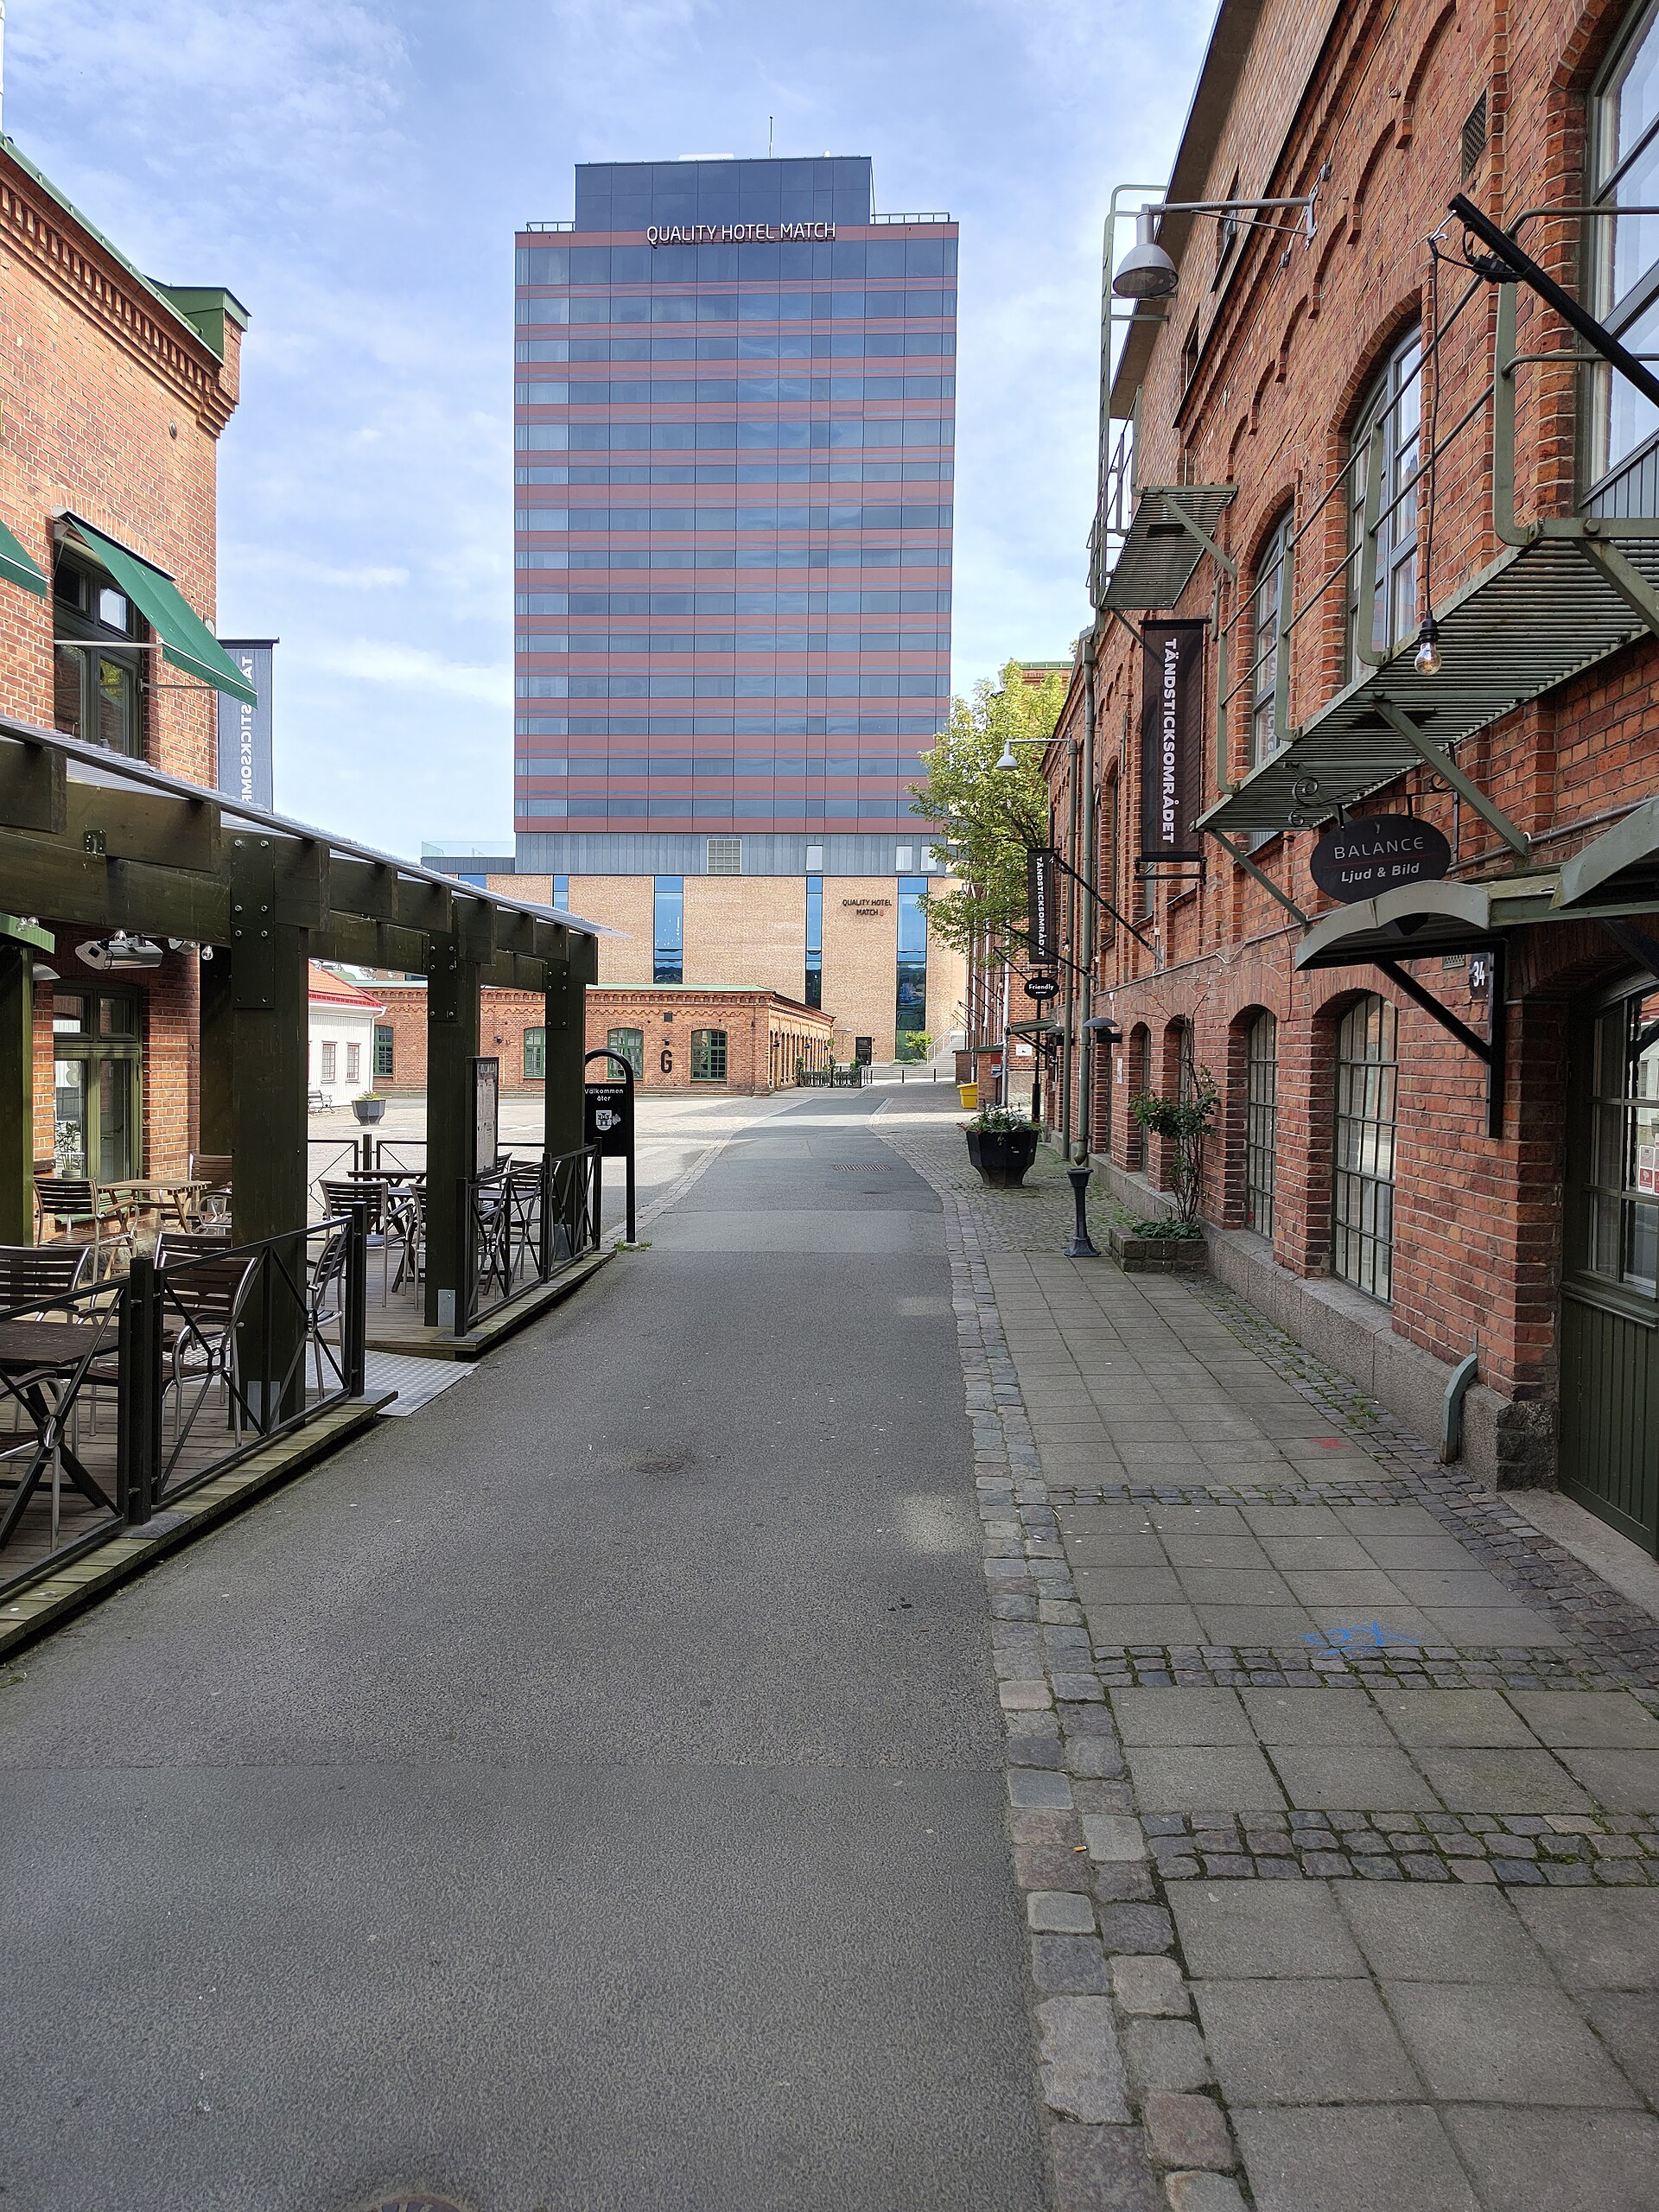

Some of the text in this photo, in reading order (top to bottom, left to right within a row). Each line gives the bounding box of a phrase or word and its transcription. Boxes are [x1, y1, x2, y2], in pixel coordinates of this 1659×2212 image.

[646, 222, 836, 244] QUALITY HOTEL MATCH
[1162, 638, 1179, 843] TÄNDSTICKSOMRÅDET
[1333, 836, 1425, 860] BALANCE
[1341, 862, 1421, 884] Ljud & Bild
[842, 899, 870, 907] QUALITY
[1036, 856, 1047, 957] TÄNDSTICKSOMRÅDT
[1472, 960, 1485, 987] 34
[660, 1049, 673, 1074] G
